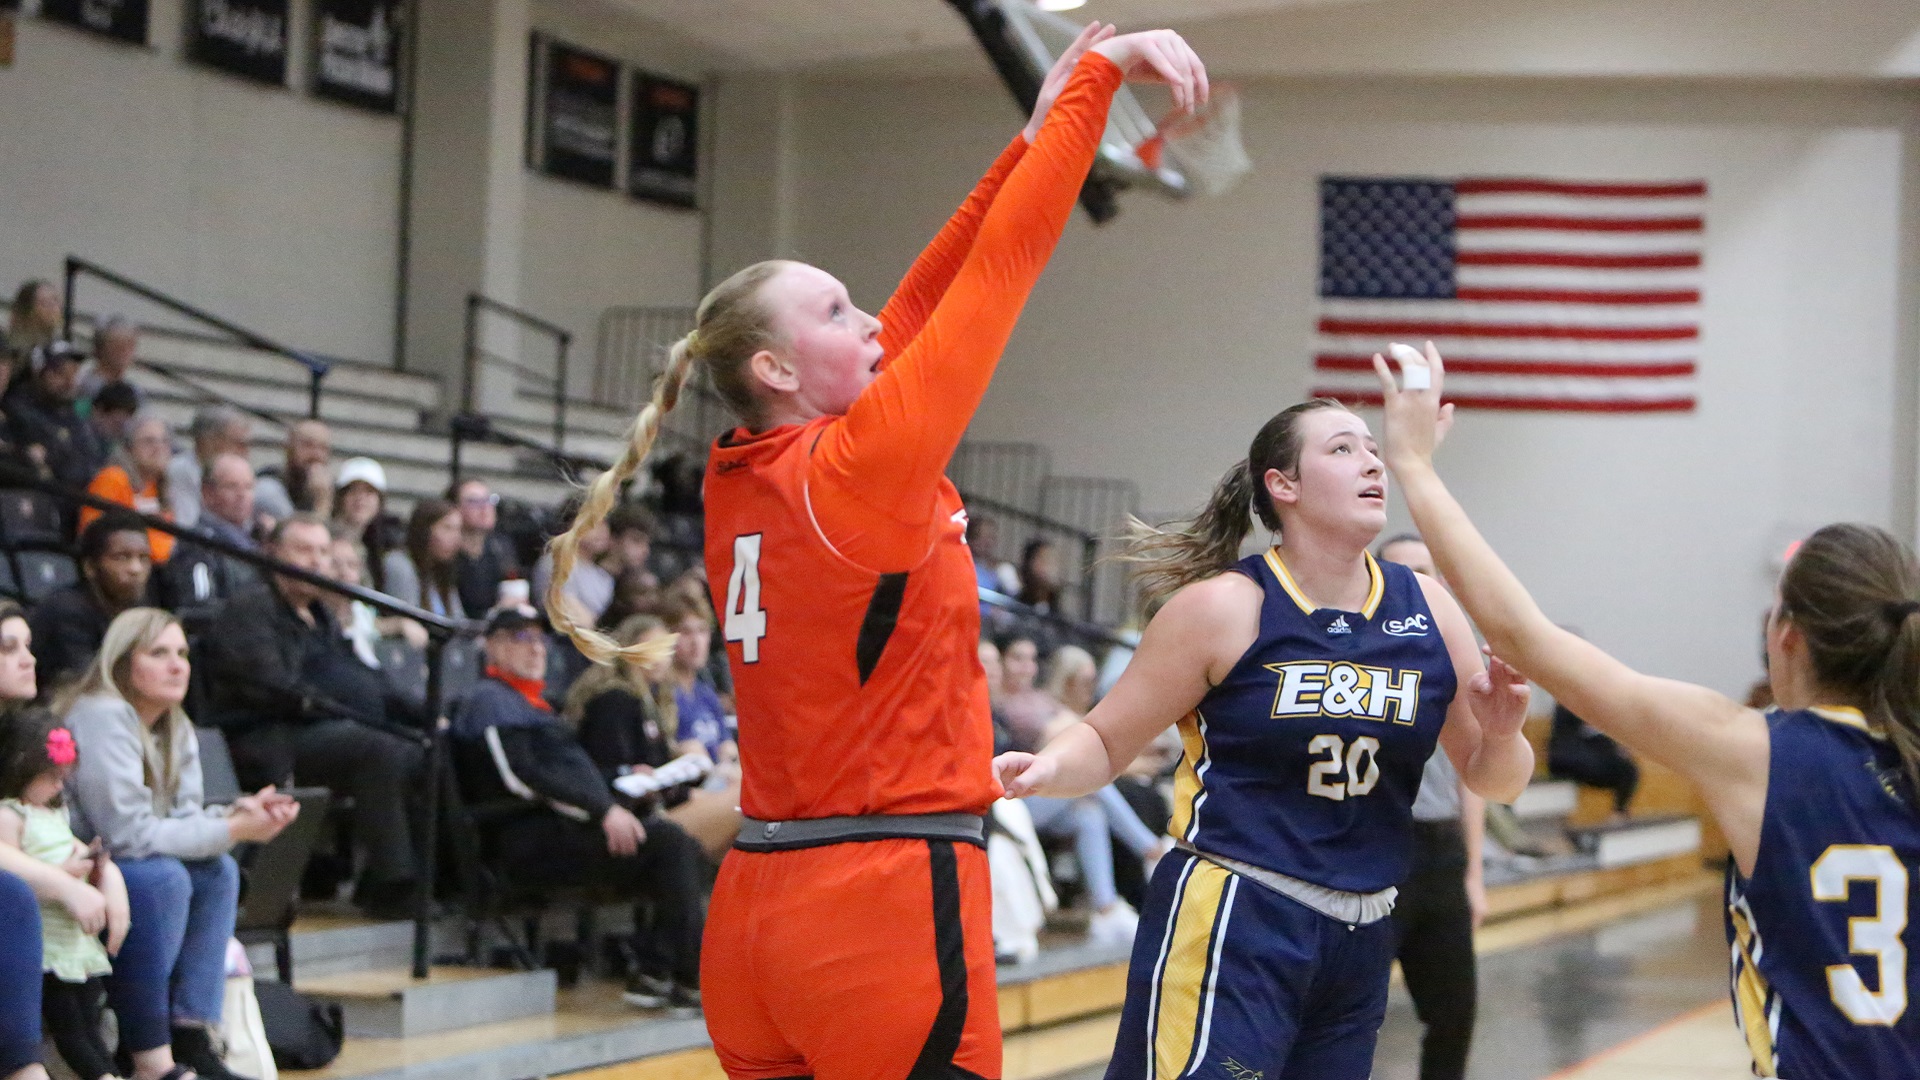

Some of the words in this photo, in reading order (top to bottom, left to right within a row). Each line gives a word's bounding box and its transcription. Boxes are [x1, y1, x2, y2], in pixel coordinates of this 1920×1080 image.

[724, 532, 767, 664] 4
[1327, 625, 1352, 634] adidas
[1389, 613, 1428, 633] SAC
[1263, 660, 1422, 726] E&H
[1307, 734, 1380, 800] 20
[1810, 844, 1909, 1027] 3
